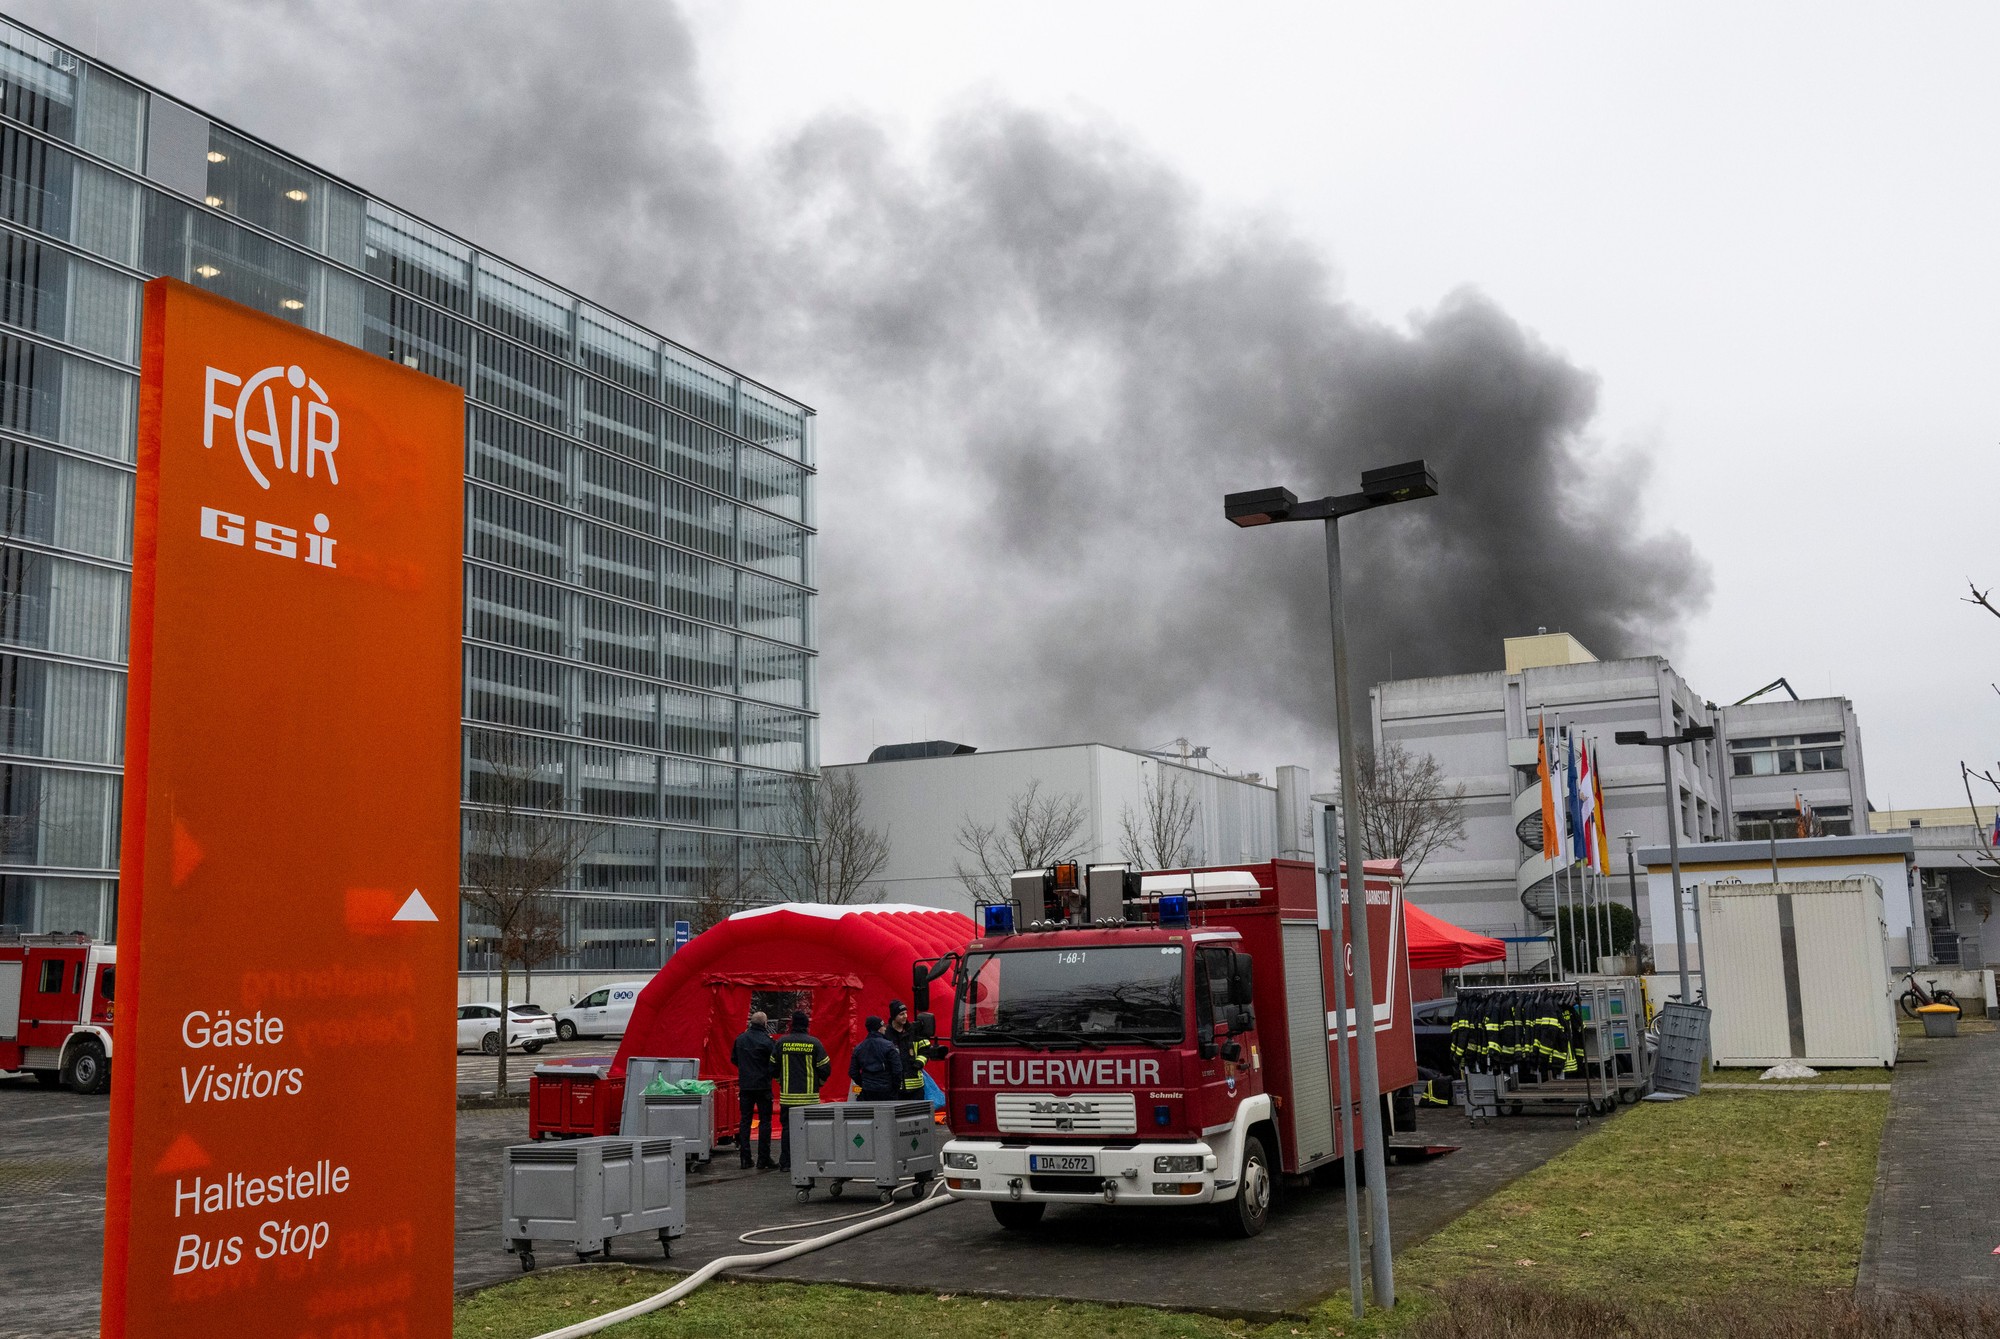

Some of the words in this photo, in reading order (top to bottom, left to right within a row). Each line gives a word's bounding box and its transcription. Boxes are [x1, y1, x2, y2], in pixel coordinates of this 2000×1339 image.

[1058, 952, 1086, 964] 1-68-1
[182, 1010, 284, 1049] Gäste
[181, 1062, 304, 1104] Visitors
[972, 1059, 1161, 1085] FEUERWEHR
[1034, 1101, 1093, 1115] MAN
[1149, 1091, 1184, 1100] Schmitz
[1041, 1157, 1056, 1169] DA
[1061, 1157, 1088, 1170] 2672
[174, 1159, 350, 1217] Haltestelle
[173, 1233, 244, 1276] Bus
[254, 1220, 330, 1261] Stop
